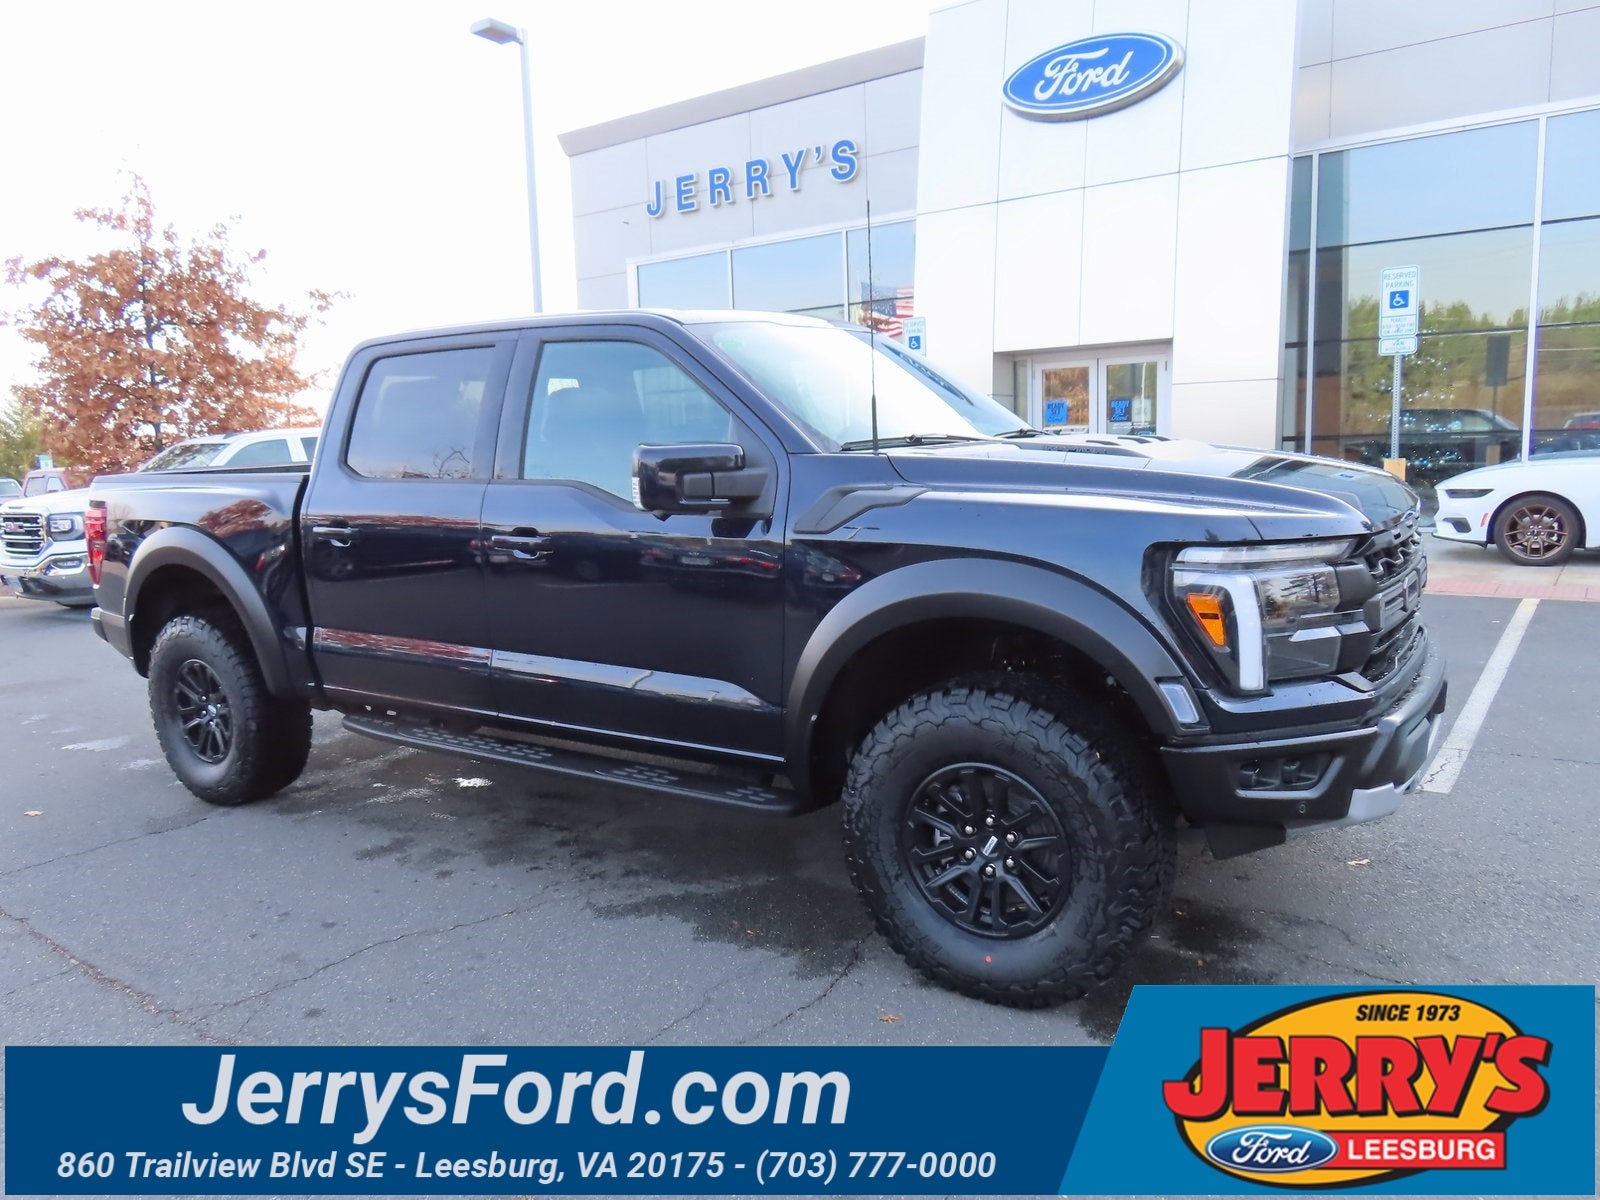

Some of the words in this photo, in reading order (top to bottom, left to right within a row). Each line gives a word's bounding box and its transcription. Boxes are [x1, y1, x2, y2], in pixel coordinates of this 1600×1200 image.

[1033, 47, 1135, 101] Ford
[645, 138, 859, 219] JERRY'S
[1383, 271, 1417, 280] RESERVED
[1385, 281, 1415, 289] PARKING
